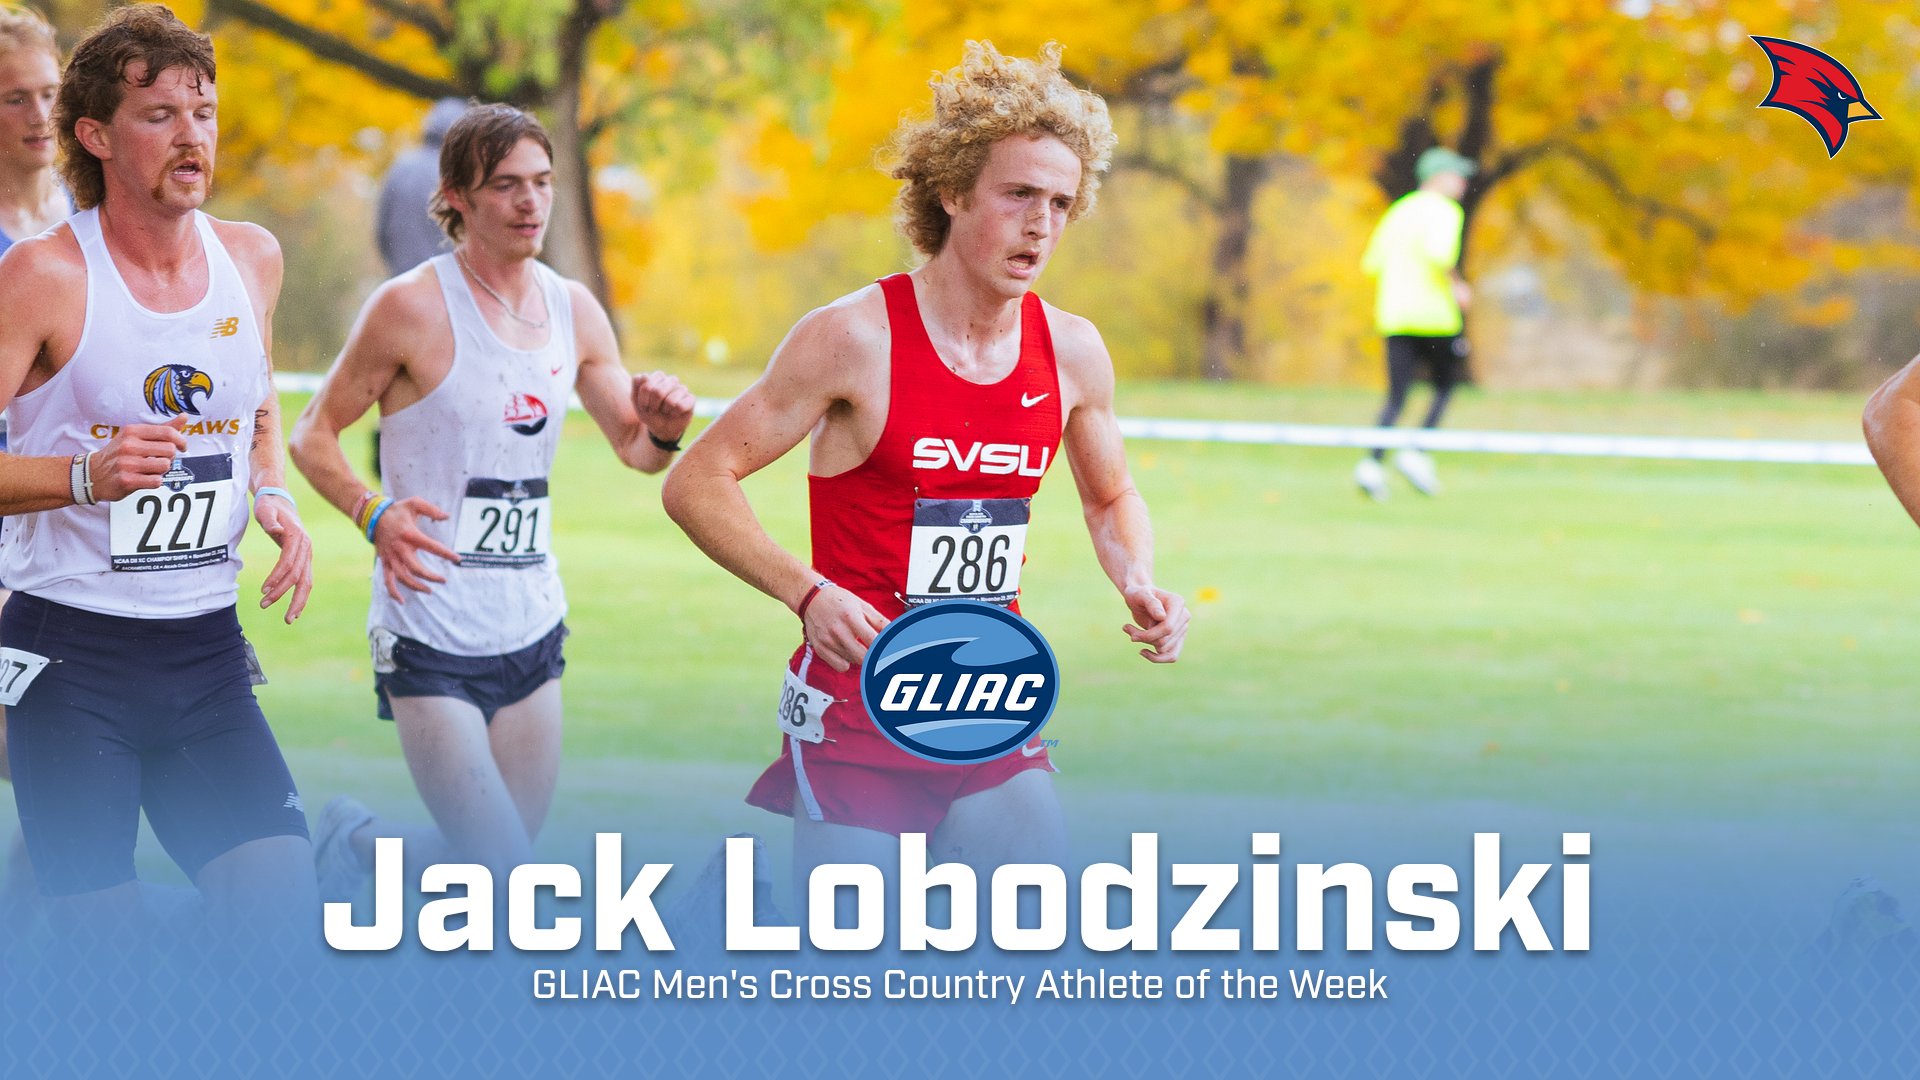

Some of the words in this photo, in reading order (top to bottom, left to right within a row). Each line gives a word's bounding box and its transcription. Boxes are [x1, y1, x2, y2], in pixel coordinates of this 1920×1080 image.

[90, 418, 240, 440] CTAWS
[912, 437, 1049, 477] SVSU
[136, 490, 216, 553] 227
[474, 506, 539, 554] 291
[928, 534, 1010, 594] 286
